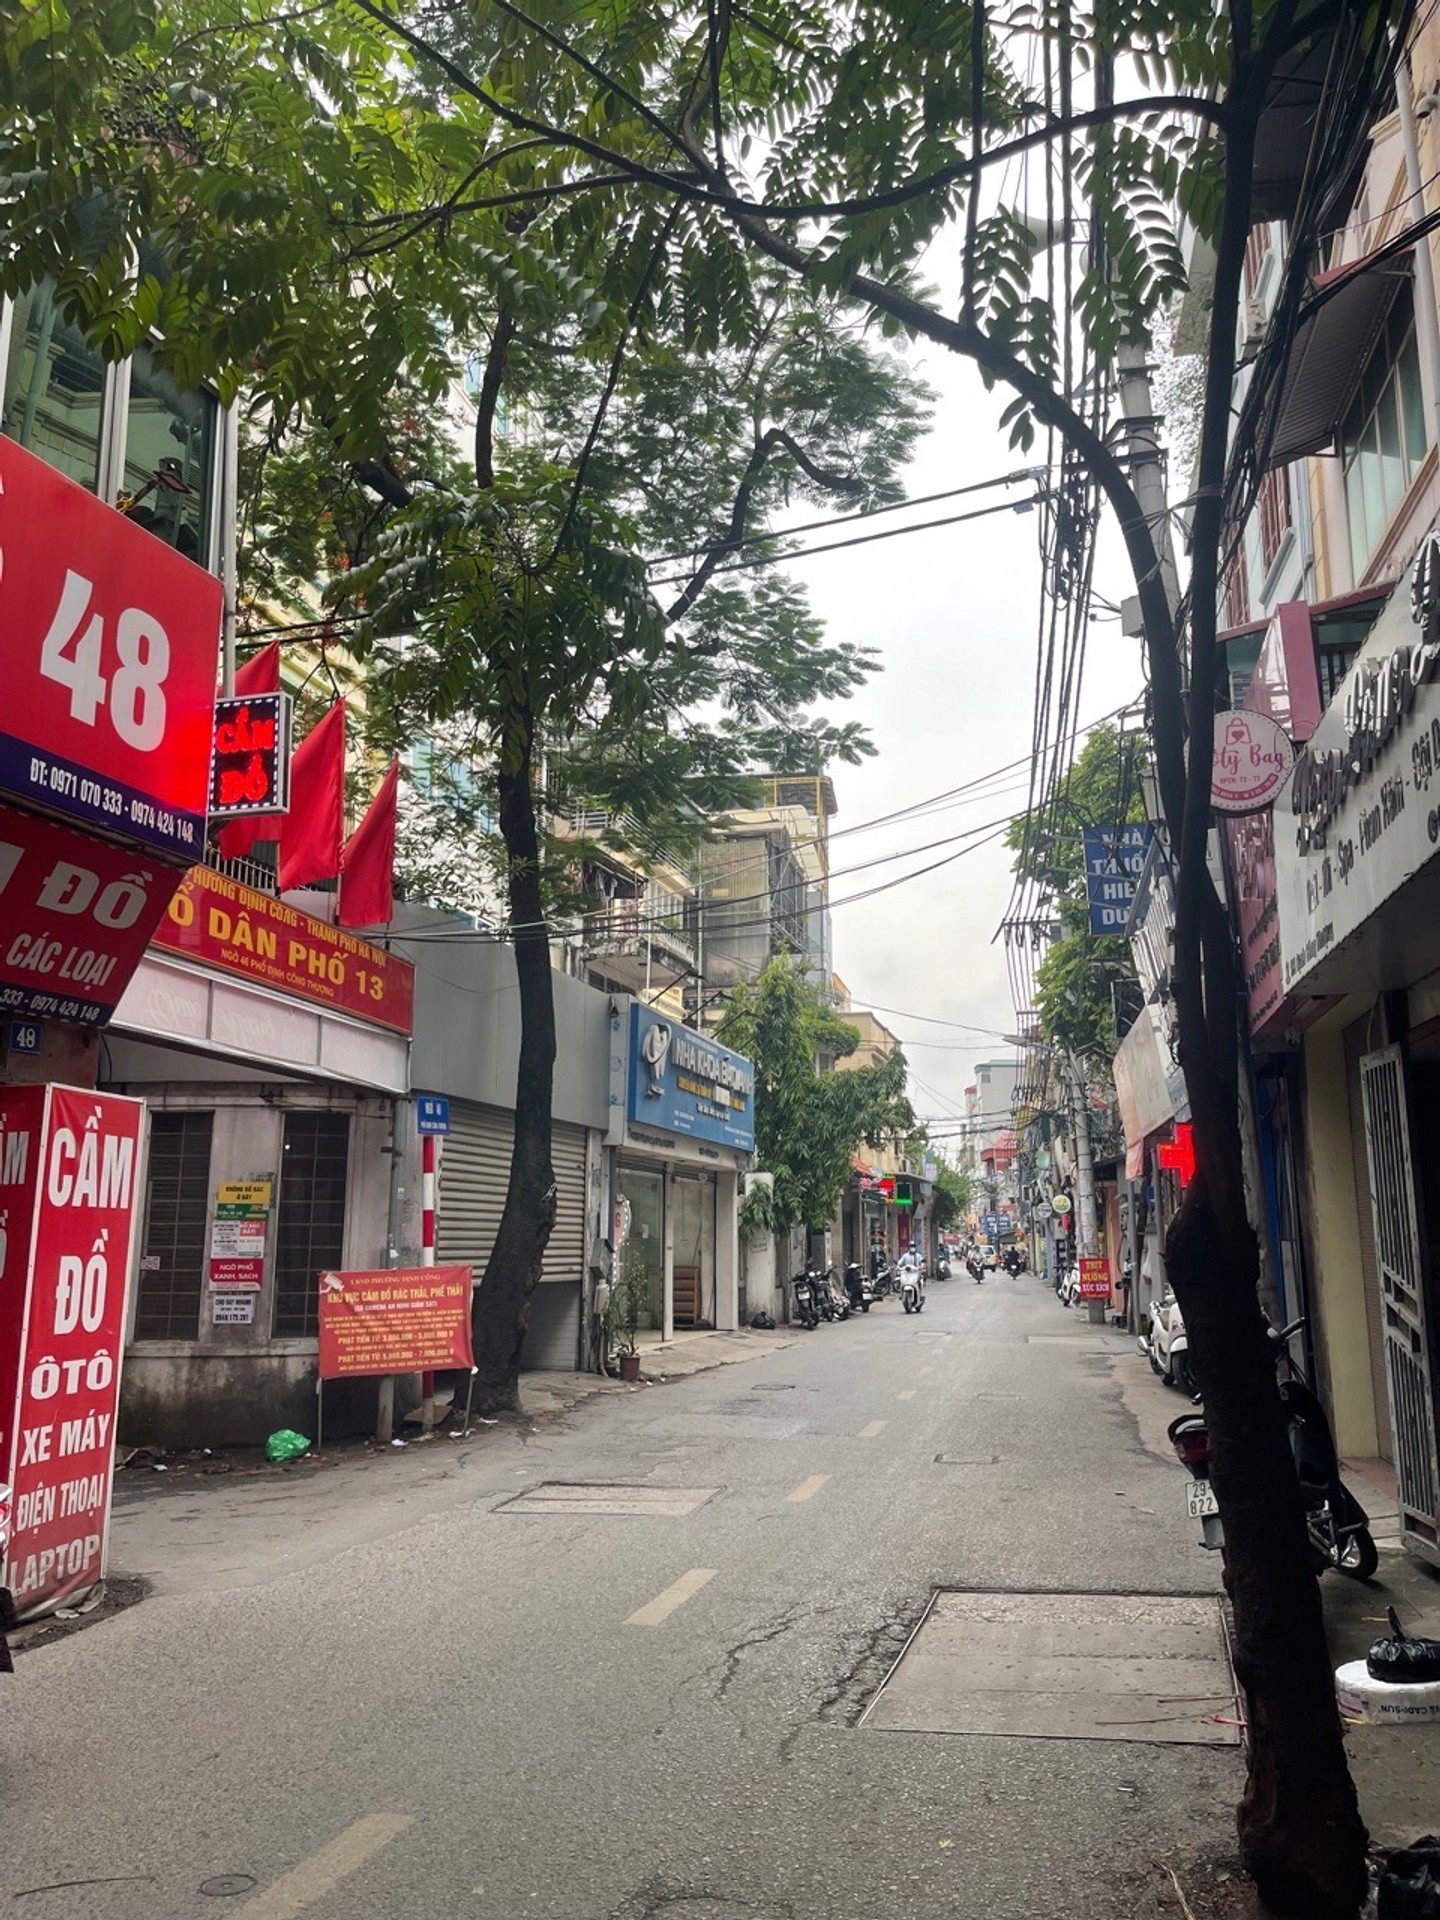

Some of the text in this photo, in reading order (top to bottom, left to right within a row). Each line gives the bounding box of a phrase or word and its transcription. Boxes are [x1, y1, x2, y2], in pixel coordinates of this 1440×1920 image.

[40, 568, 170, 753] 48
[1249, 744, 1284, 773] Bag
[30, 757, 194, 844] ĐT: 0971 070 333 0974 424 148
[35, 860, 153, 930] ĐỒ
[239, 889, 267, 914] ĐỊNH
[269, 902, 298, 928] CÔNG
[5, 931, 118, 991] CÁC LOẠI
[168, 881, 384, 1001] Ổ DÂN PHỐ 13
[250, 957, 267, 973] PHỐ
[267, 965, 285, 979] ĐỊNH
[3, 988, 100, 1021] 333 0974 424 148
[16, 1027, 36, 1049] 48
[48, 1105, 134, 1209] CẦM
[54, 1229, 109, 1336] ĐỒ
[30, 1349, 113, 1400] ÔTÔ
[20, 1409, 110, 1467] XE MÁY
[16, 1473, 104, 1539] ĐIỆN THOẠI
[1190, 1497, 1218, 1515] 822.
[1193, 1482, 1211, 1498] 29-
[10, 1534, 100, 1598] LAPTOP
